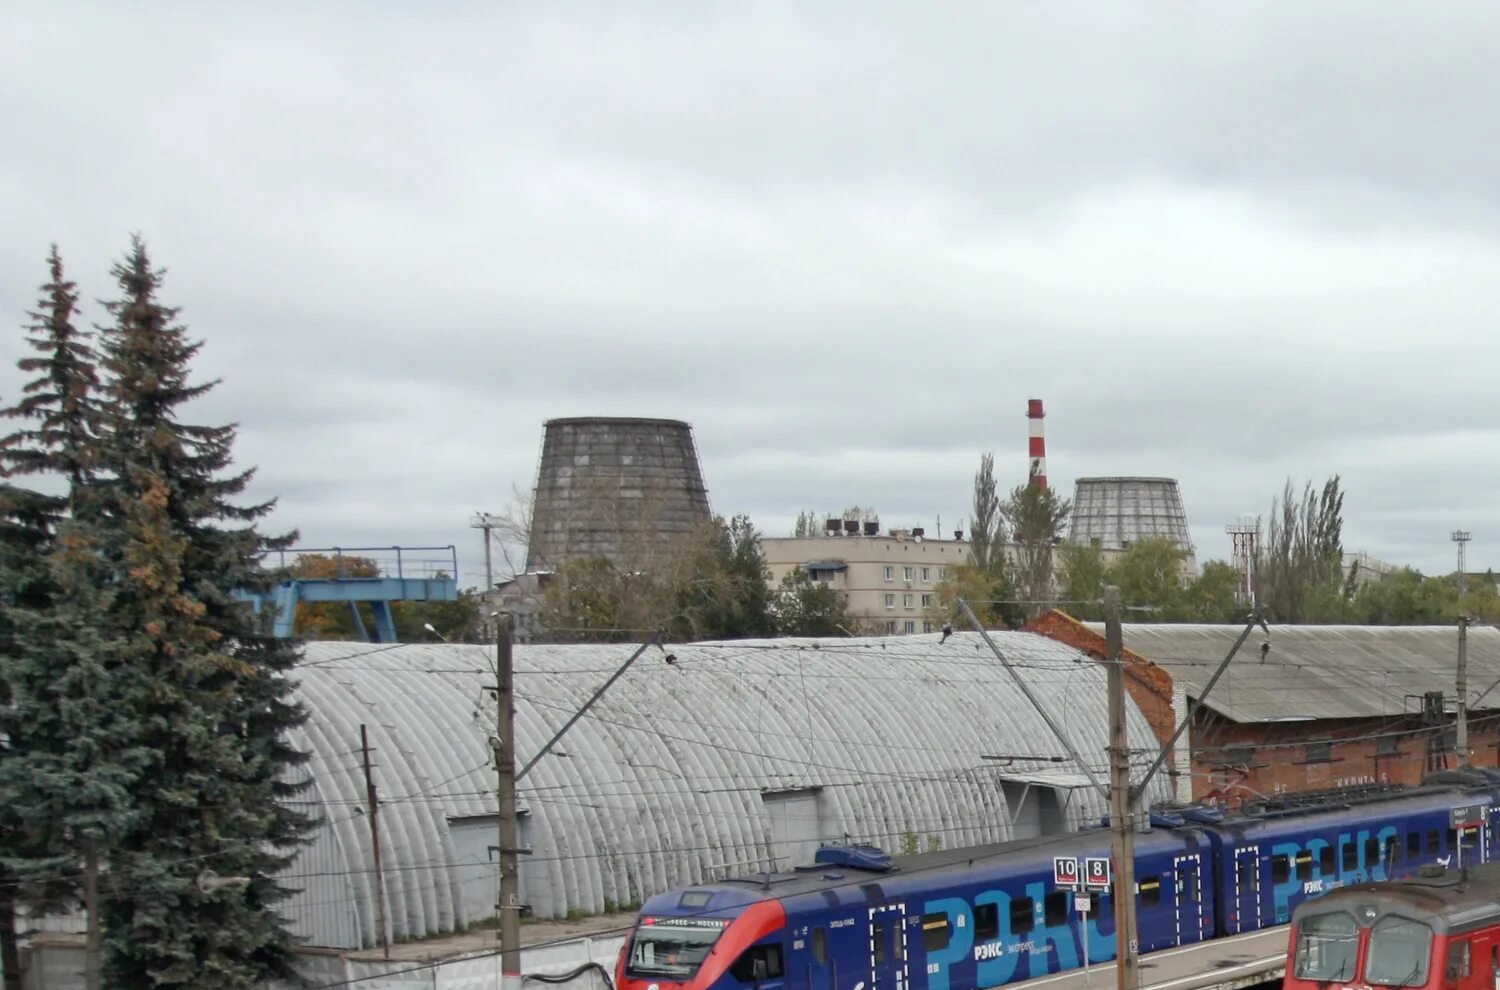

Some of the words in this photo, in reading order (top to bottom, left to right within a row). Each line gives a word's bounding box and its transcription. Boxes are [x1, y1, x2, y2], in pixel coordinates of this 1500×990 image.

[1058, 861, 1075, 875] 10
[1093, 861, 1103, 876] 8
[974, 942, 1003, 960] РЭКС
